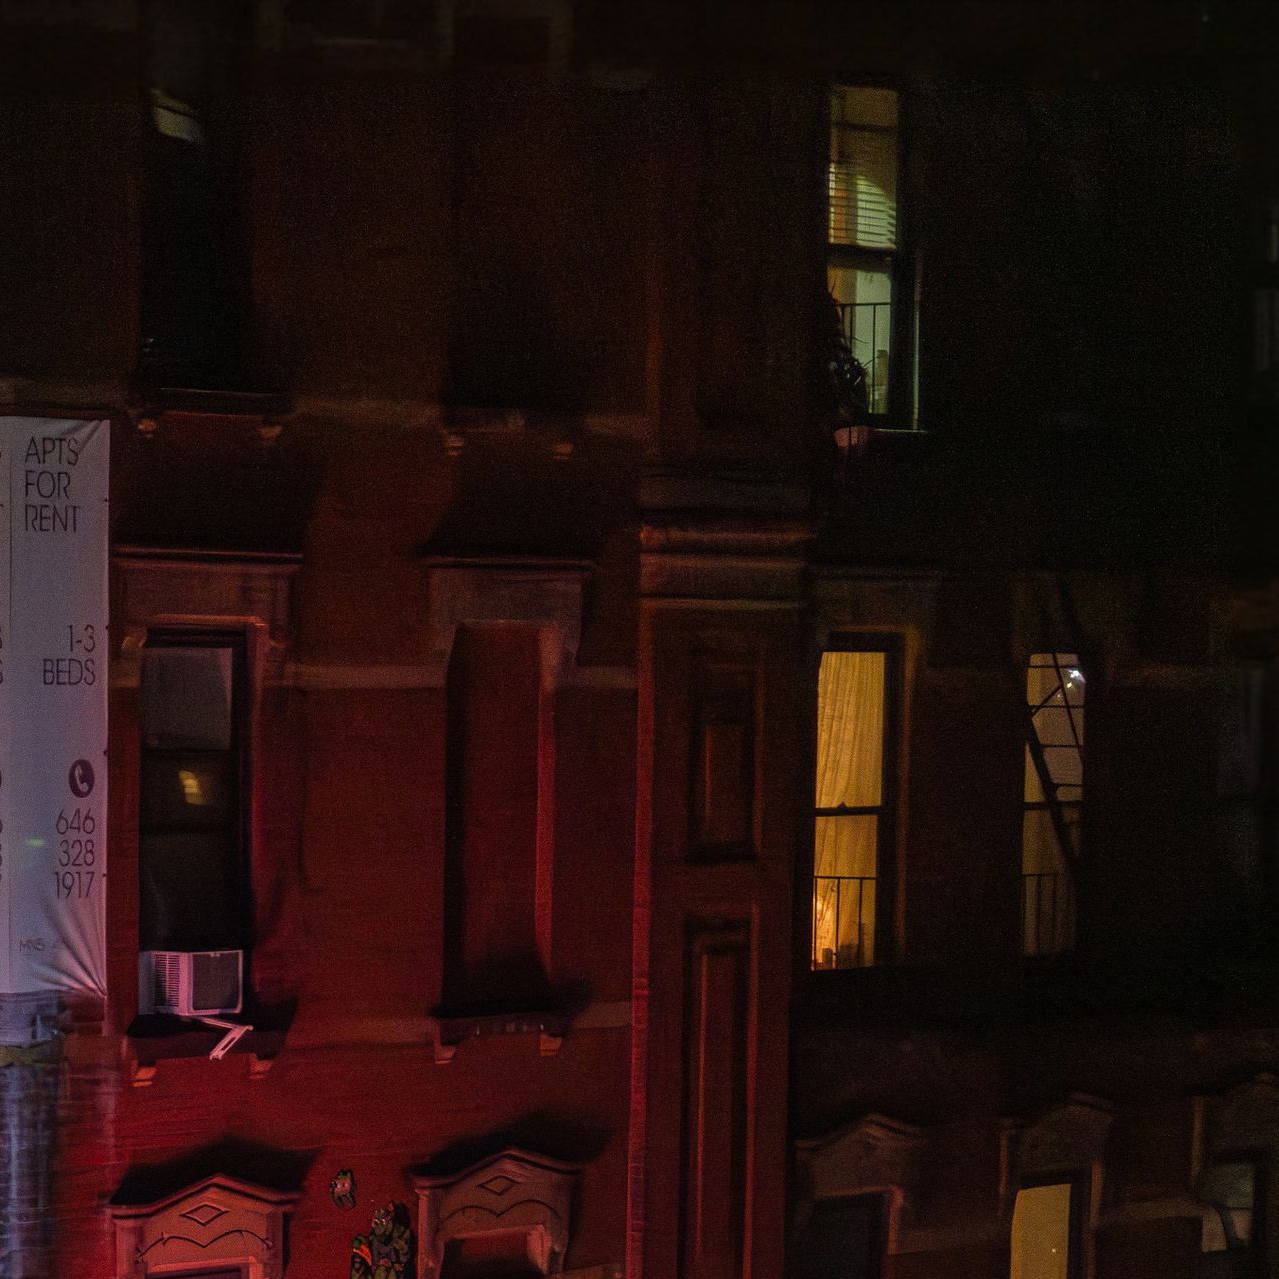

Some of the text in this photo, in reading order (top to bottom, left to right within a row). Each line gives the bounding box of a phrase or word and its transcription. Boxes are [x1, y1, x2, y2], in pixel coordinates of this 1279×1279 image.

[24, 436, 79, 466] APTS
[25, 470, 71, 499] FOR
[25, 505, 81, 533] RENT
[67, 624, 96, 652] 1-3
[42, 658, 95, 686] BEDS
[55, 809, 96, 836] 646
[59, 840, 96, 868] 328
[54, 872, 95, 900] 1917
